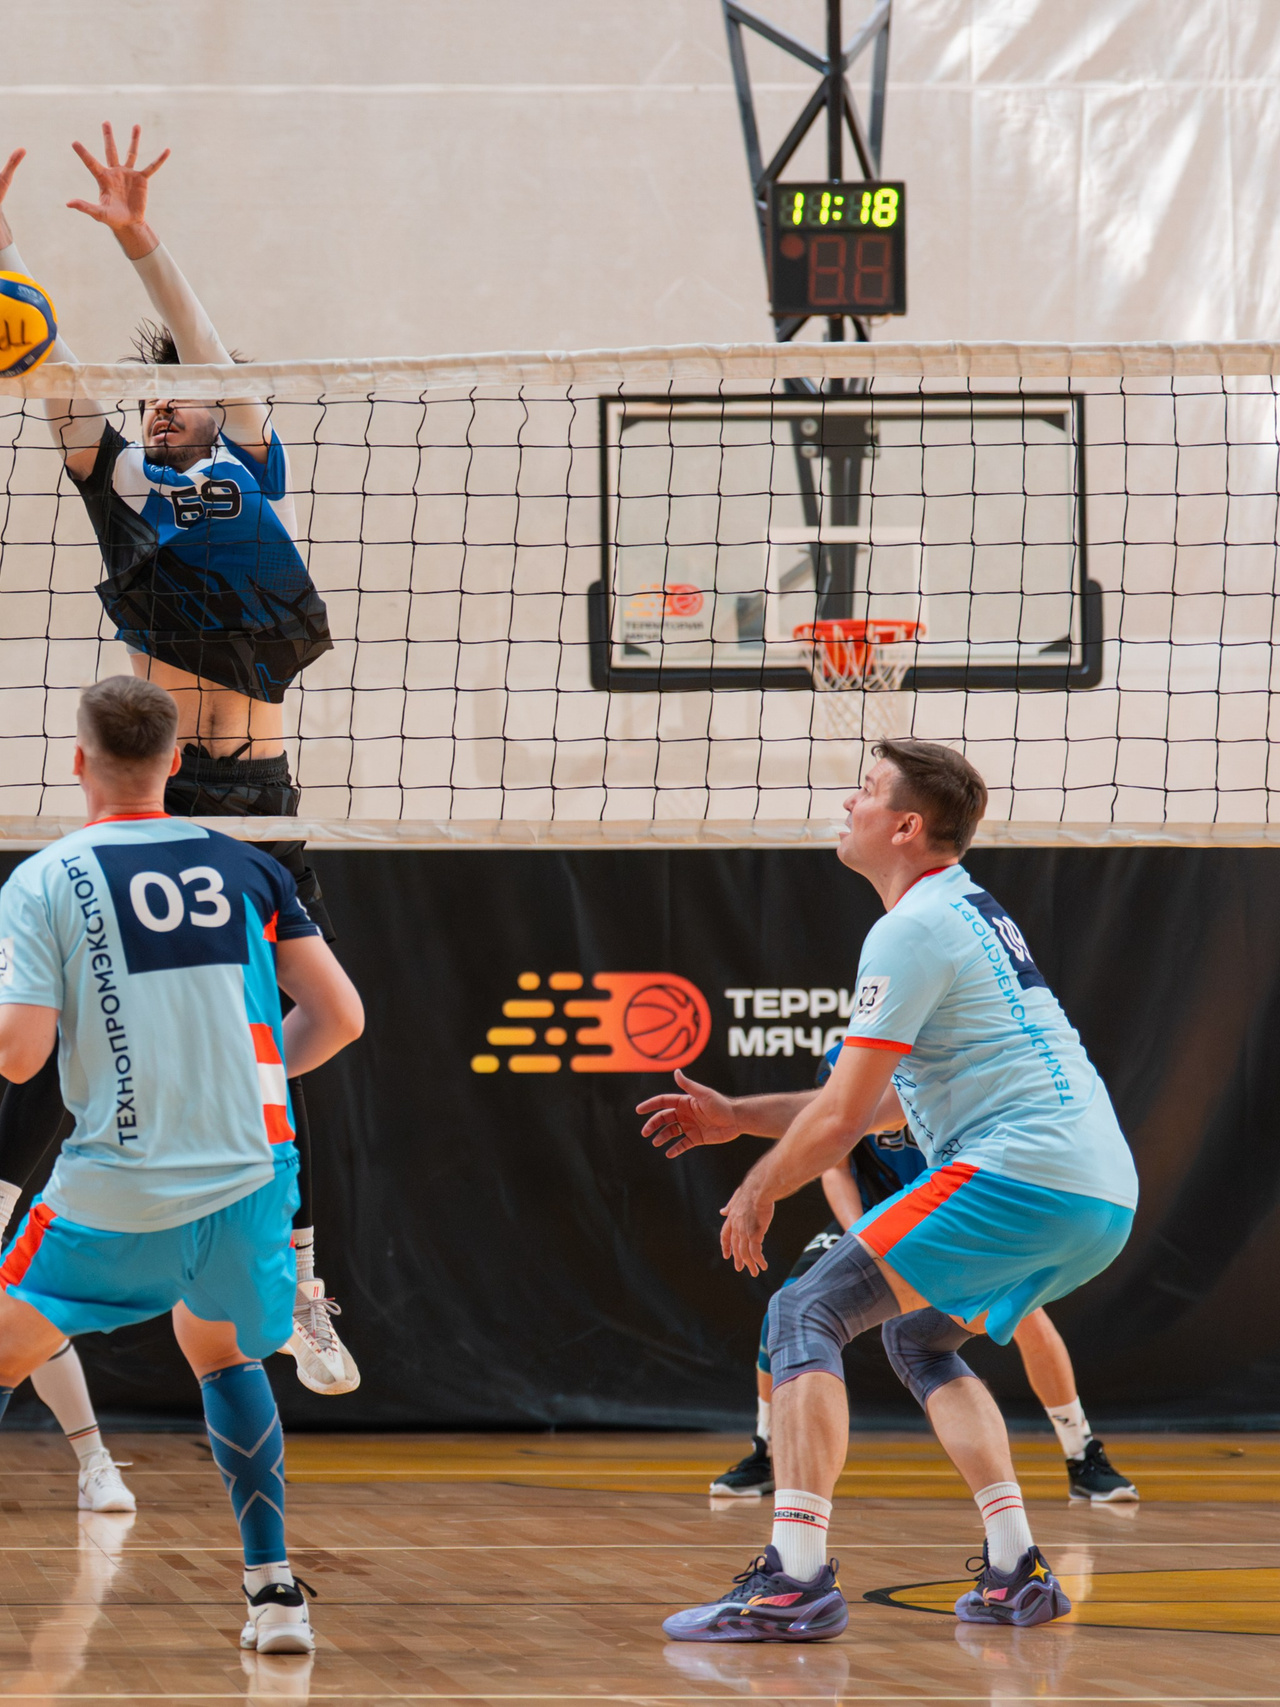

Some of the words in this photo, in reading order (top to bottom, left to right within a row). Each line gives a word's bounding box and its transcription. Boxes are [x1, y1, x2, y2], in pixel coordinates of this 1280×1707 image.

[792, 188, 899, 228] 11:18
[170, 479, 243, 530] 69
[129, 865, 232, 933] 03
[61, 854, 139, 1146] ТЕХНОПРОМЭКСПОРТ
